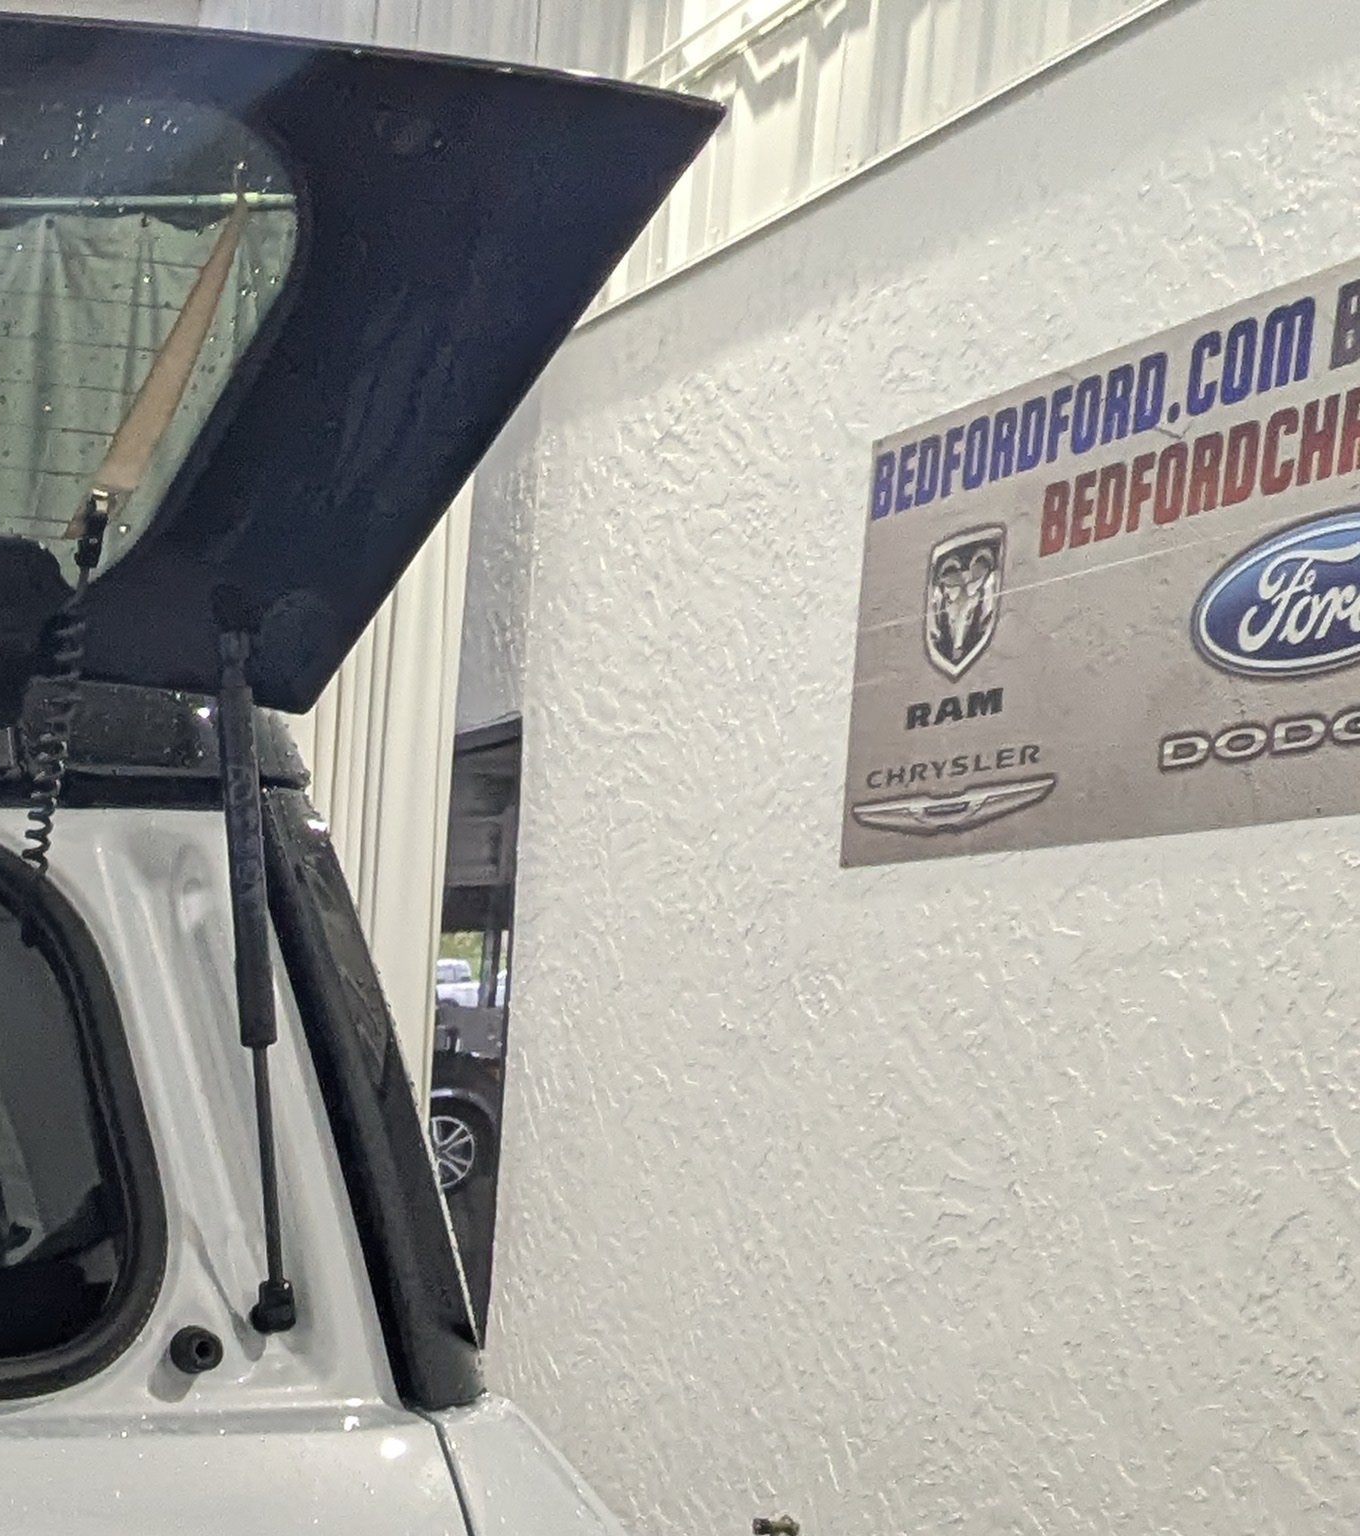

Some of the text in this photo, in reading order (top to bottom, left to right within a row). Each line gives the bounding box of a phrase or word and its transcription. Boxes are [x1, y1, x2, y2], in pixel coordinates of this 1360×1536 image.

[871, 296, 1316, 521] BEDFORDFORD.COM
[1237, 541, 1360, 653] For
[905, 687, 1004, 730] RAM
[866, 744, 1041, 789] CHRYSLER
